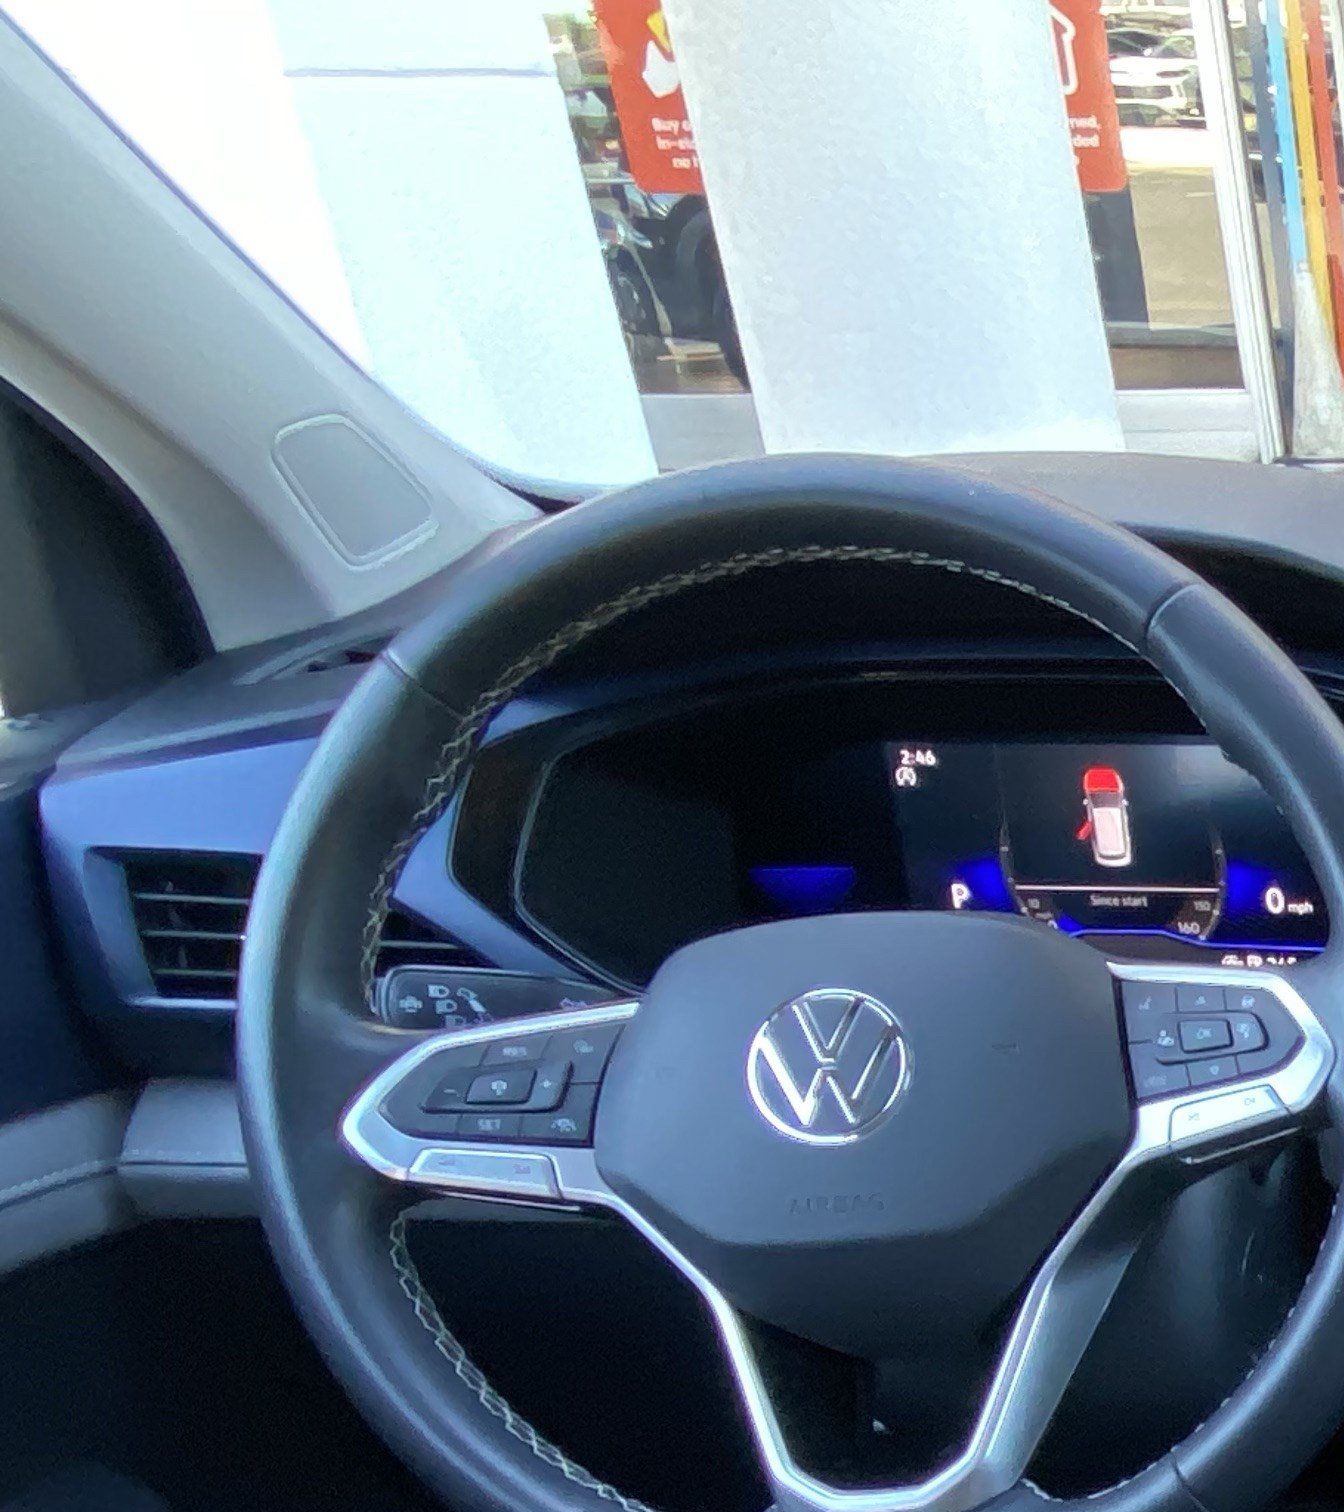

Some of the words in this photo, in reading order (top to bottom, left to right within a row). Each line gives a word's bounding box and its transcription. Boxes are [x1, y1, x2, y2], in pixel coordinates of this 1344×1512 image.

[899, 748, 937, 766] 2:46
[951, 883, 971, 909] P
[1090, 895, 1119, 907] Since
[1122, 896, 1148, 908] start
[1264, 887, 1285, 914] 0
[1288, 903, 1314, 915] mph
